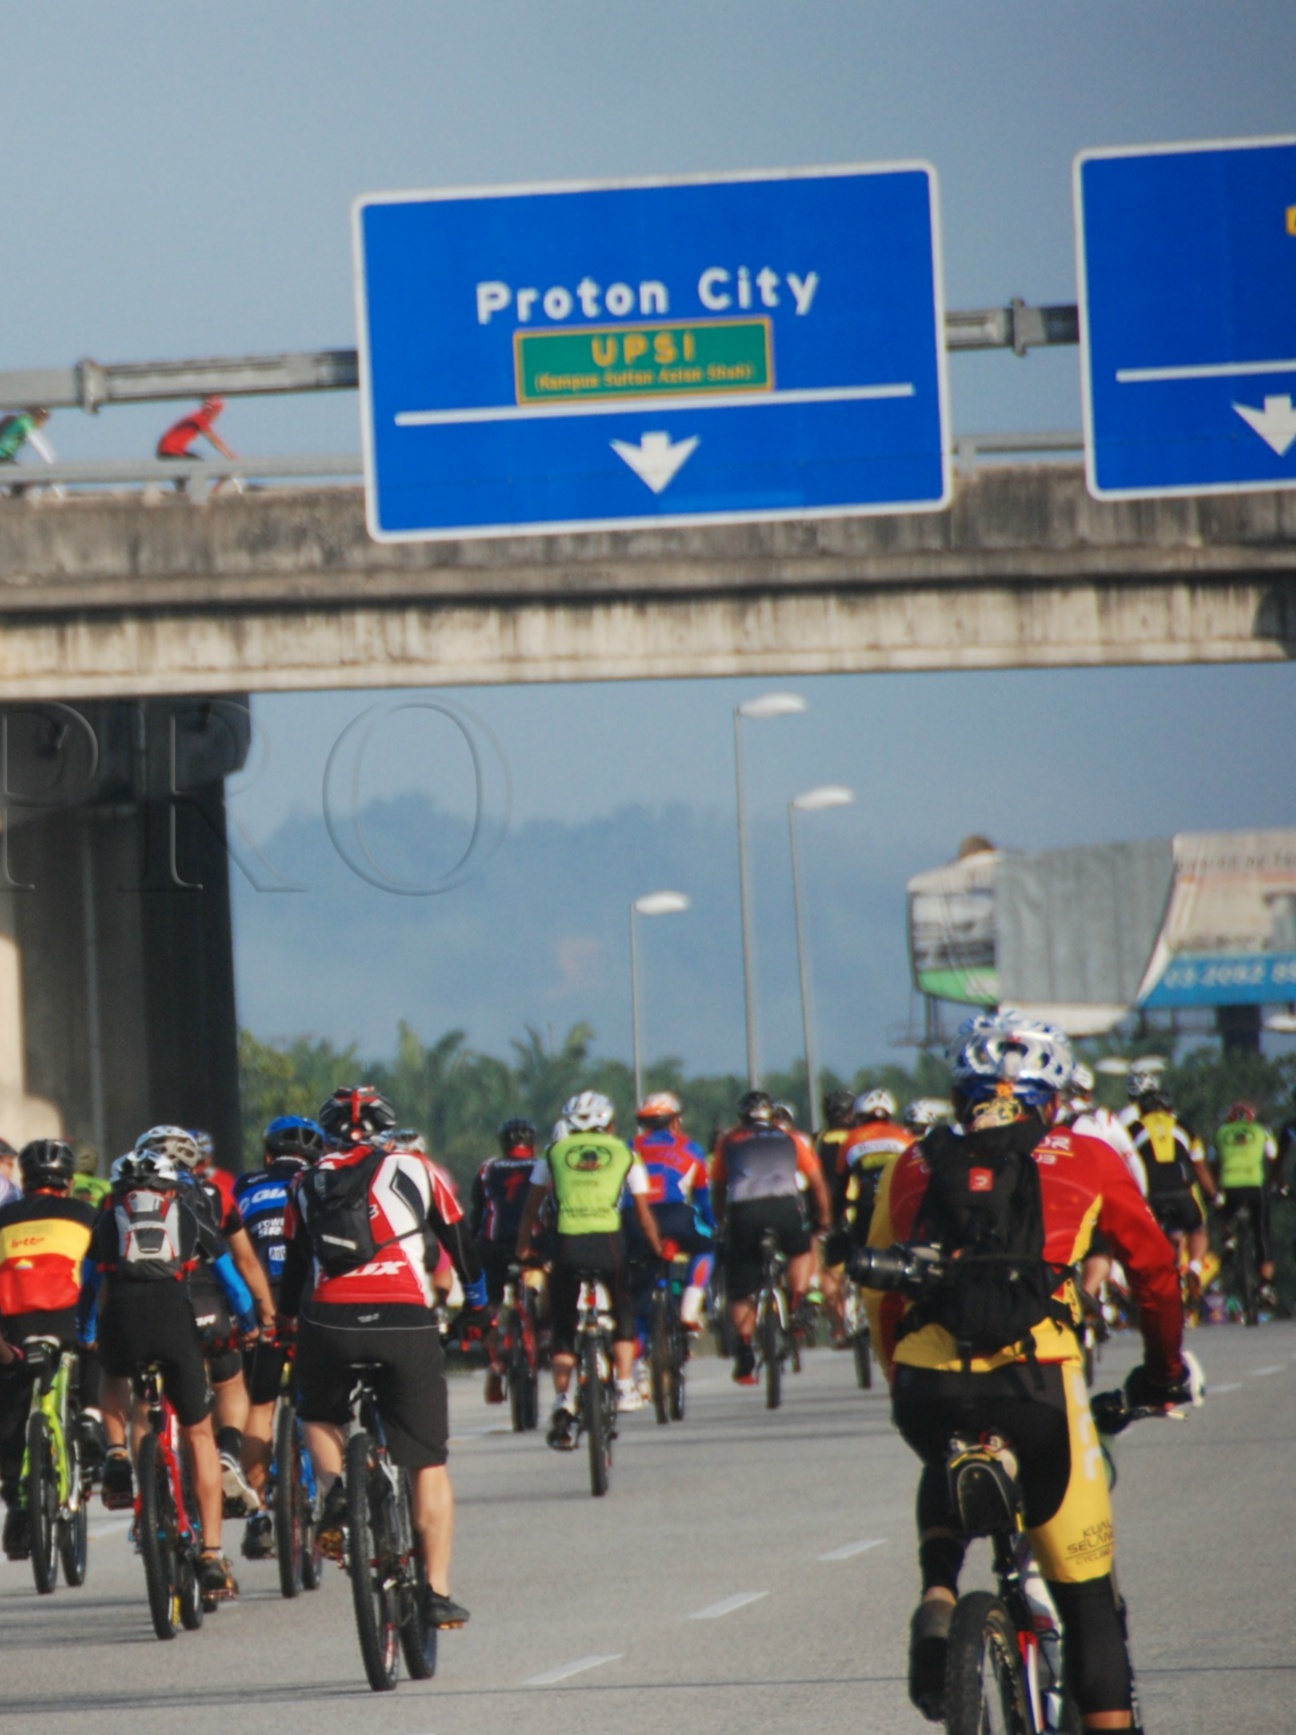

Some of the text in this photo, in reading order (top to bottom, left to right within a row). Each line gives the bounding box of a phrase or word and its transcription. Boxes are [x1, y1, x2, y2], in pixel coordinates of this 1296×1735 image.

[476, 265, 819, 324] Proton City
[591, 331, 695, 366] UPSI
[604, 367, 653, 387] Sultan
